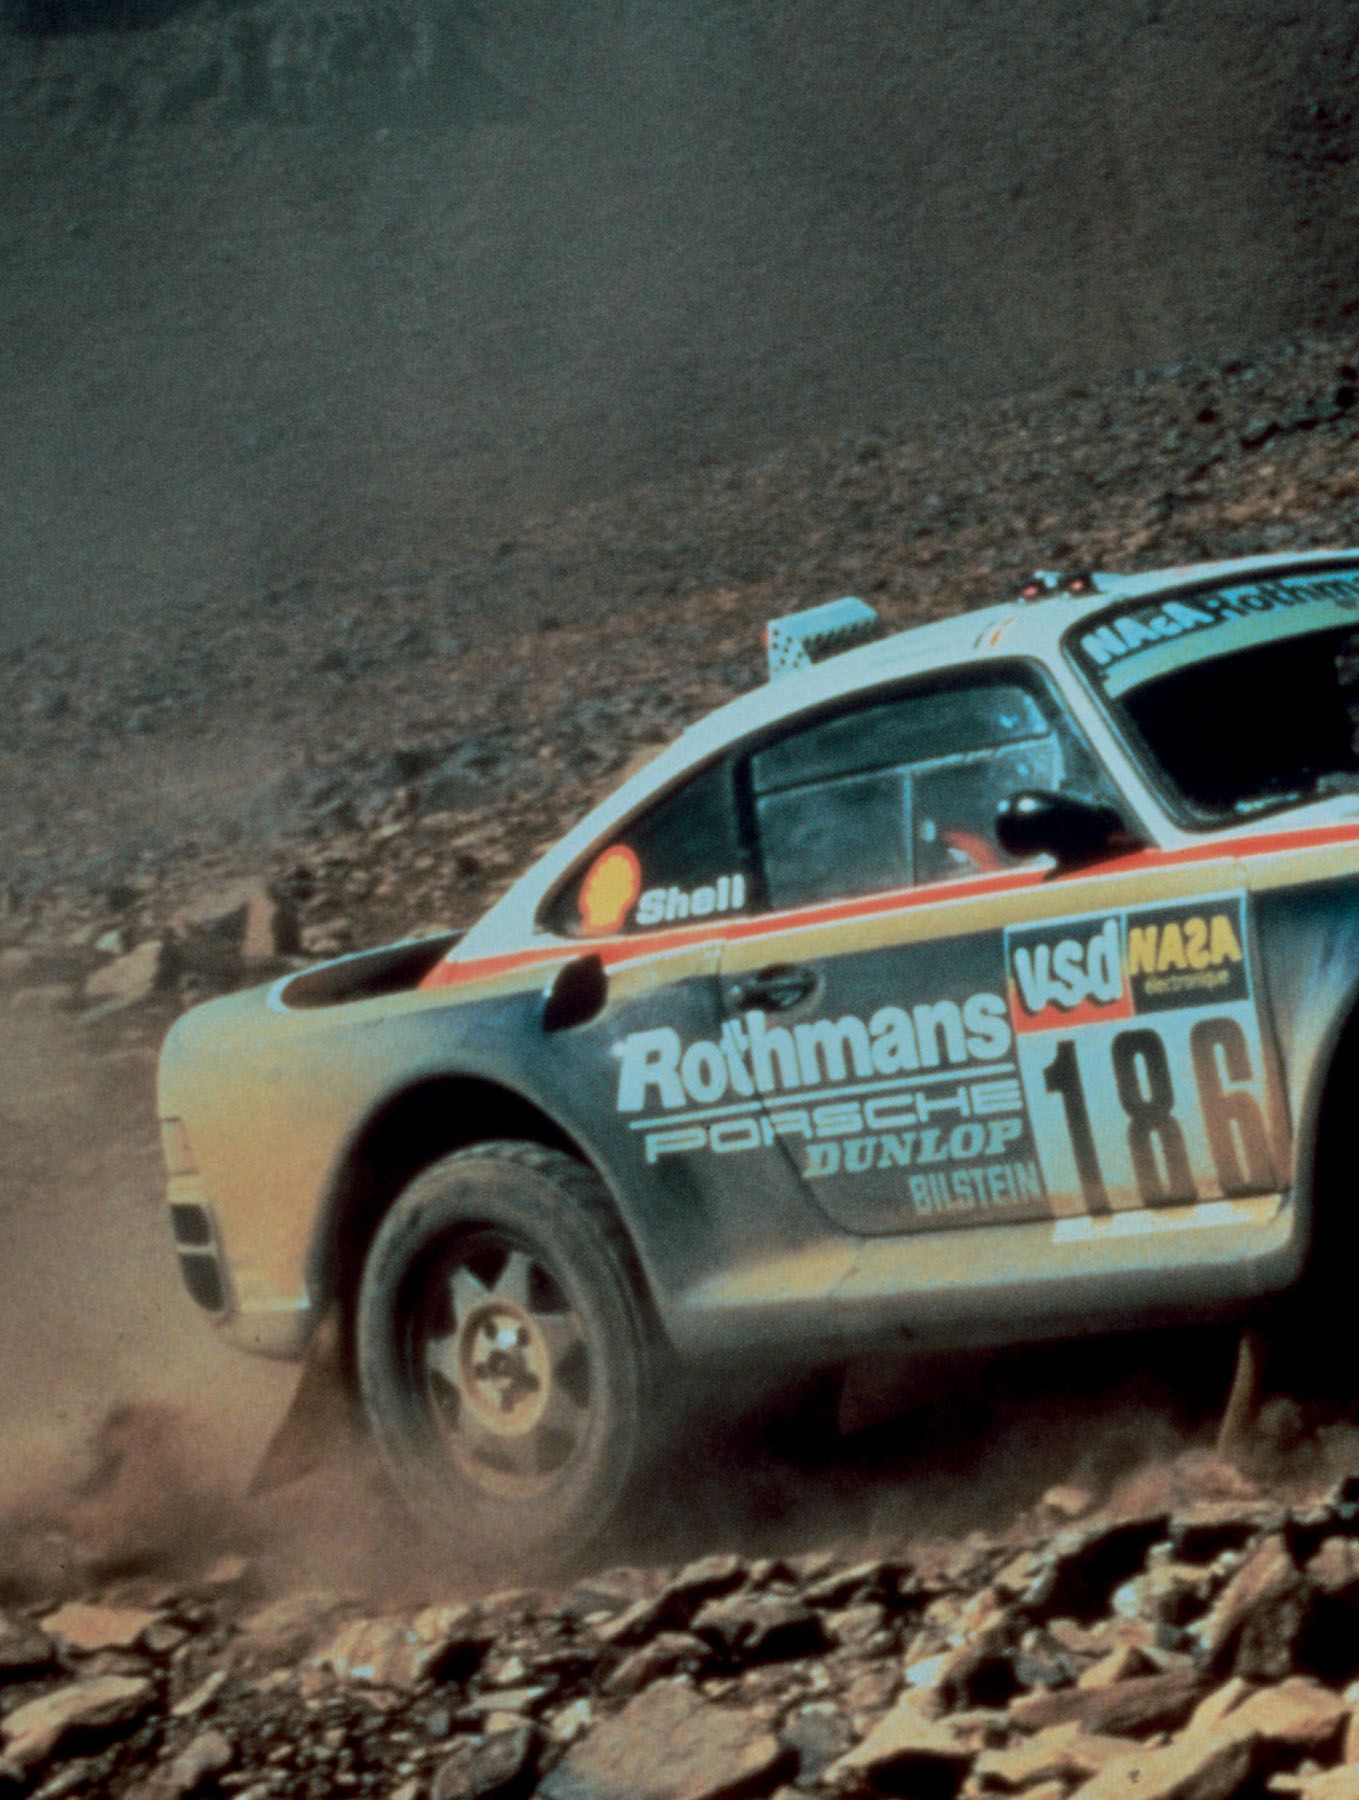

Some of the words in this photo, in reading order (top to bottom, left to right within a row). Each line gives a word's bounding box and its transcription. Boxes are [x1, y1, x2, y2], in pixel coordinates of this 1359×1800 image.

[636, 874, 746, 924] Shell
[616, 992, 1012, 1113] Rothmans
[645, 1079, 1023, 1164] PORSCHE
[802, 1117, 1023, 1178] DUNLOP
[1042, 1016, 1270, 1220] 186
[908, 1160, 1041, 1216] BILSTEIN
